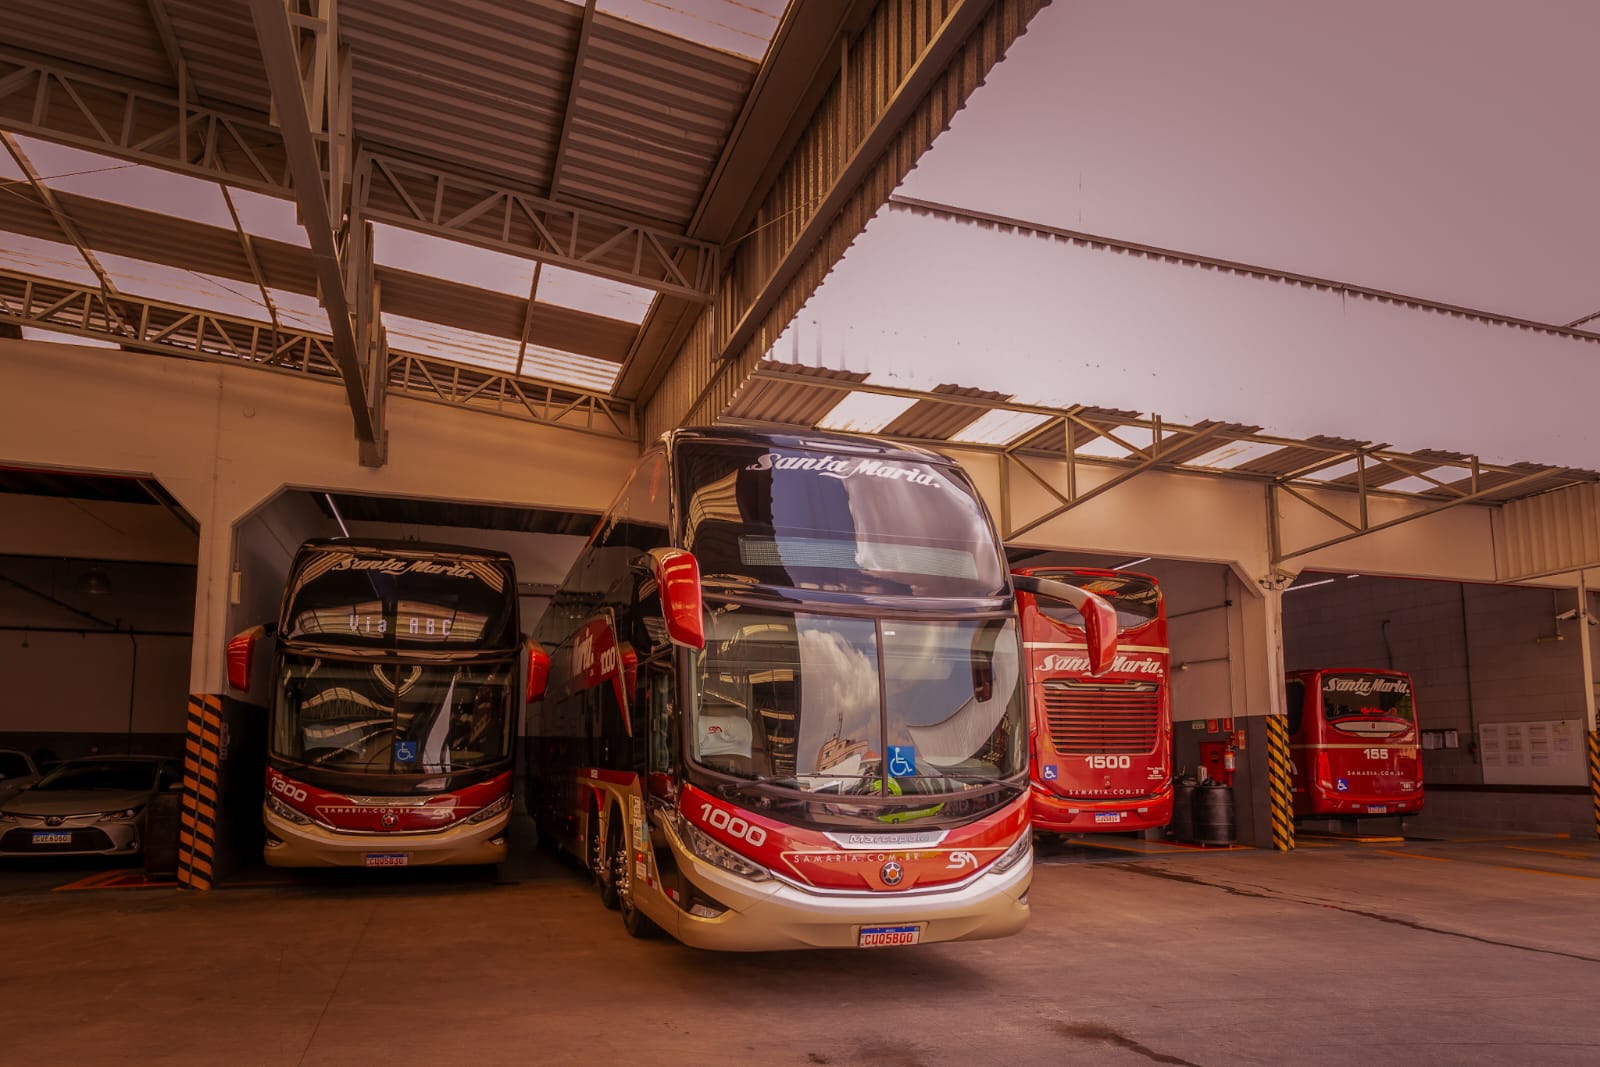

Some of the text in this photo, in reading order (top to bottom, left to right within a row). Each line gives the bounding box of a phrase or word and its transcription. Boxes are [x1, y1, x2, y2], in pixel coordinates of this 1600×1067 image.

[746, 453, 848, 475] Santa
[332, 558, 406, 571] Santa
[350, 615, 452, 636] Via ABC
[1323, 677, 1371, 692] Santa
[1363, 748, 1389, 760] 155
[1084, 755, 1131, 769] 1500
[271, 777, 308, 803] 1300
[1068, 788, 1145, 796] SAMARIA.COM.BR
[324, 807, 412, 815] SAMARIA.COM.BR
[700, 803, 768, 848] 1000
[848, 834, 930, 845] Marcopolo
[793, 852, 920, 864] SAMARIA.COM.BR
